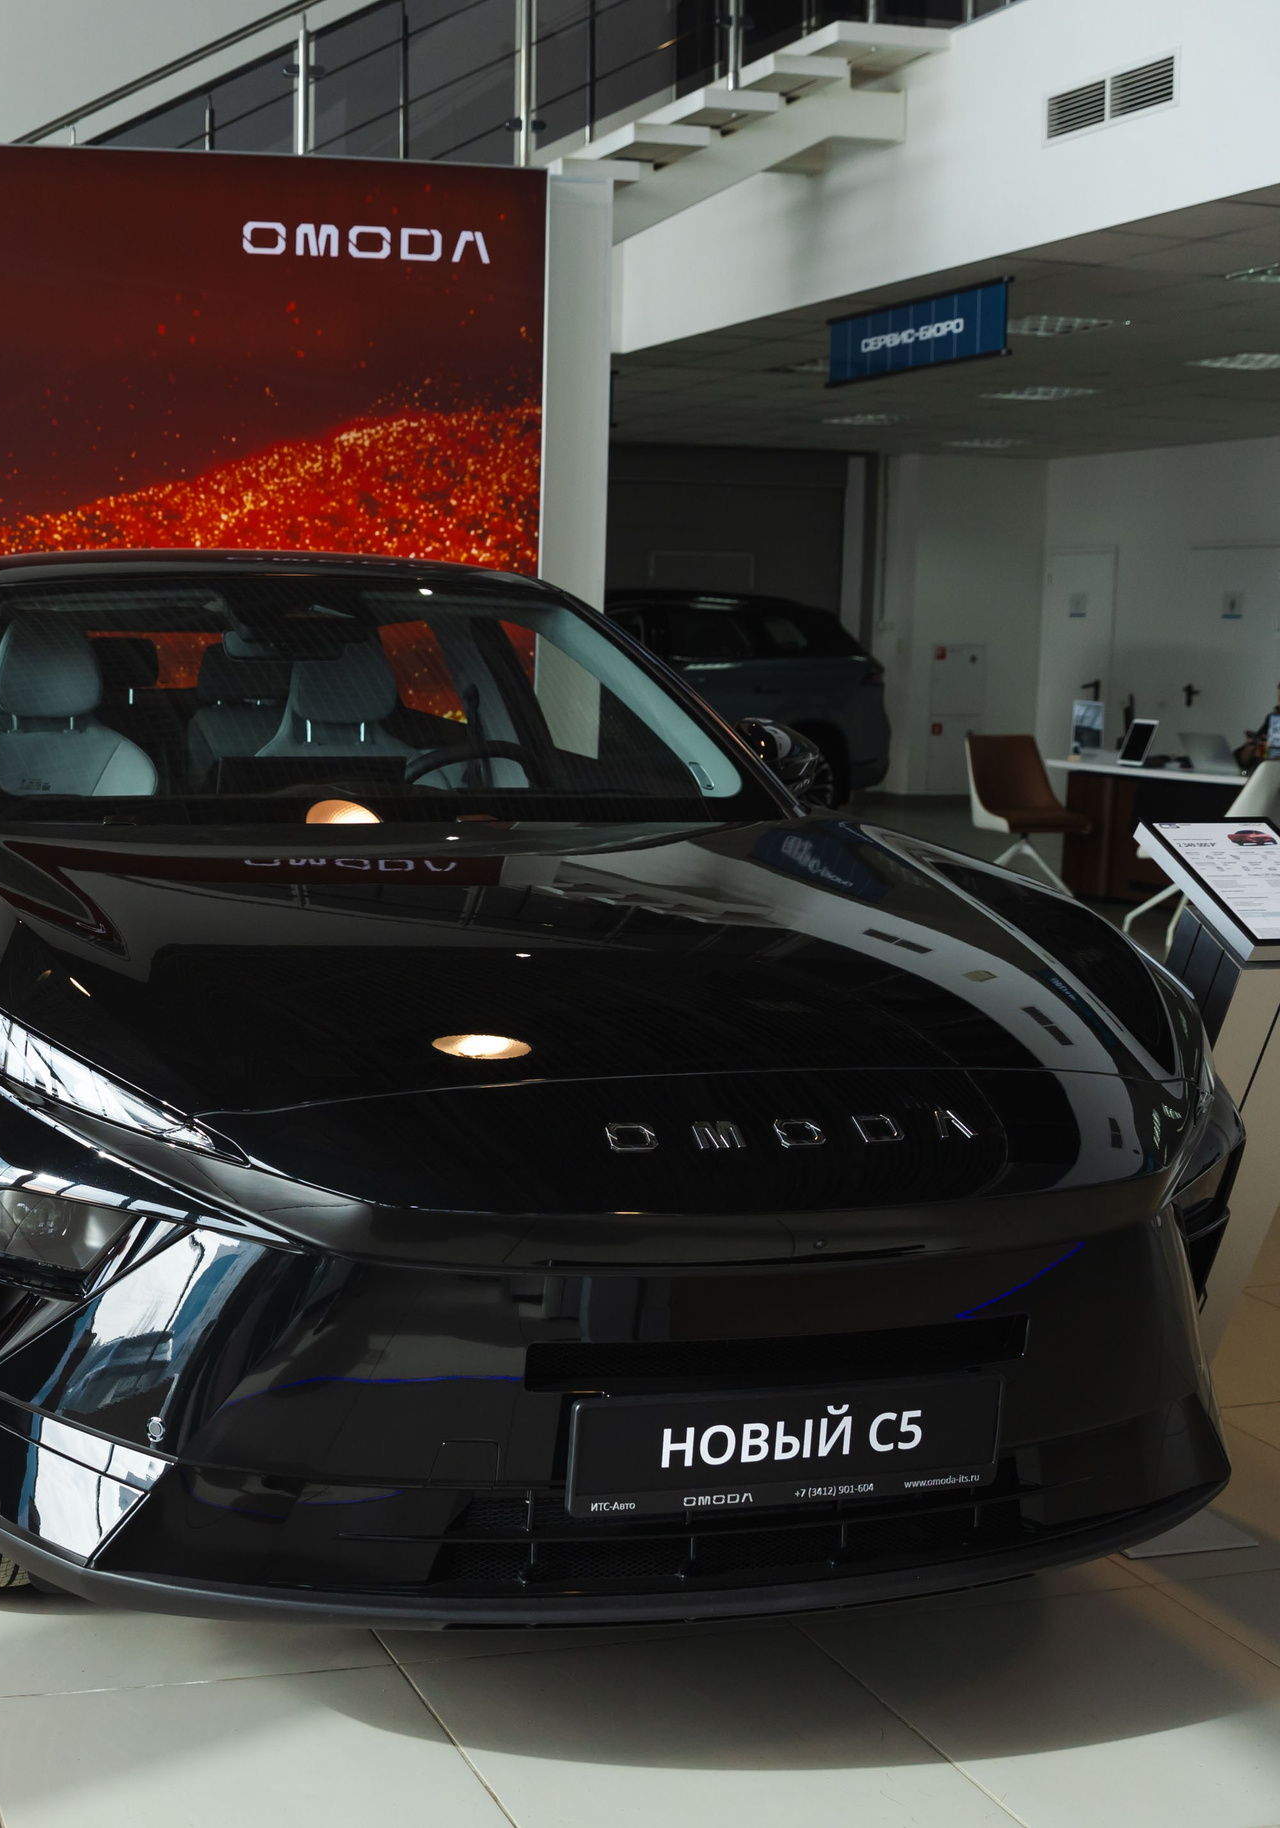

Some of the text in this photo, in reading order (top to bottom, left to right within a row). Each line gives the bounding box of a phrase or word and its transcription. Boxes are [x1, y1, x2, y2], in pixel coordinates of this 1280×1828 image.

[242, 220, 491, 265] OMODA
[860, 317, 965, 353] СЕРВИС-БЮРО
[604, 1109, 980, 1153] OMODA
[660, 1404, 923, 1469] НОВЫЙ C5
[794, 1482, 874, 1499] +7 (3412) 901-604
[903, 1473, 980, 1490] www.omoda-its.ru
[590, 1502, 636, 1512] ИТС-Авто
[683, 1492, 753, 1507] OMODA
